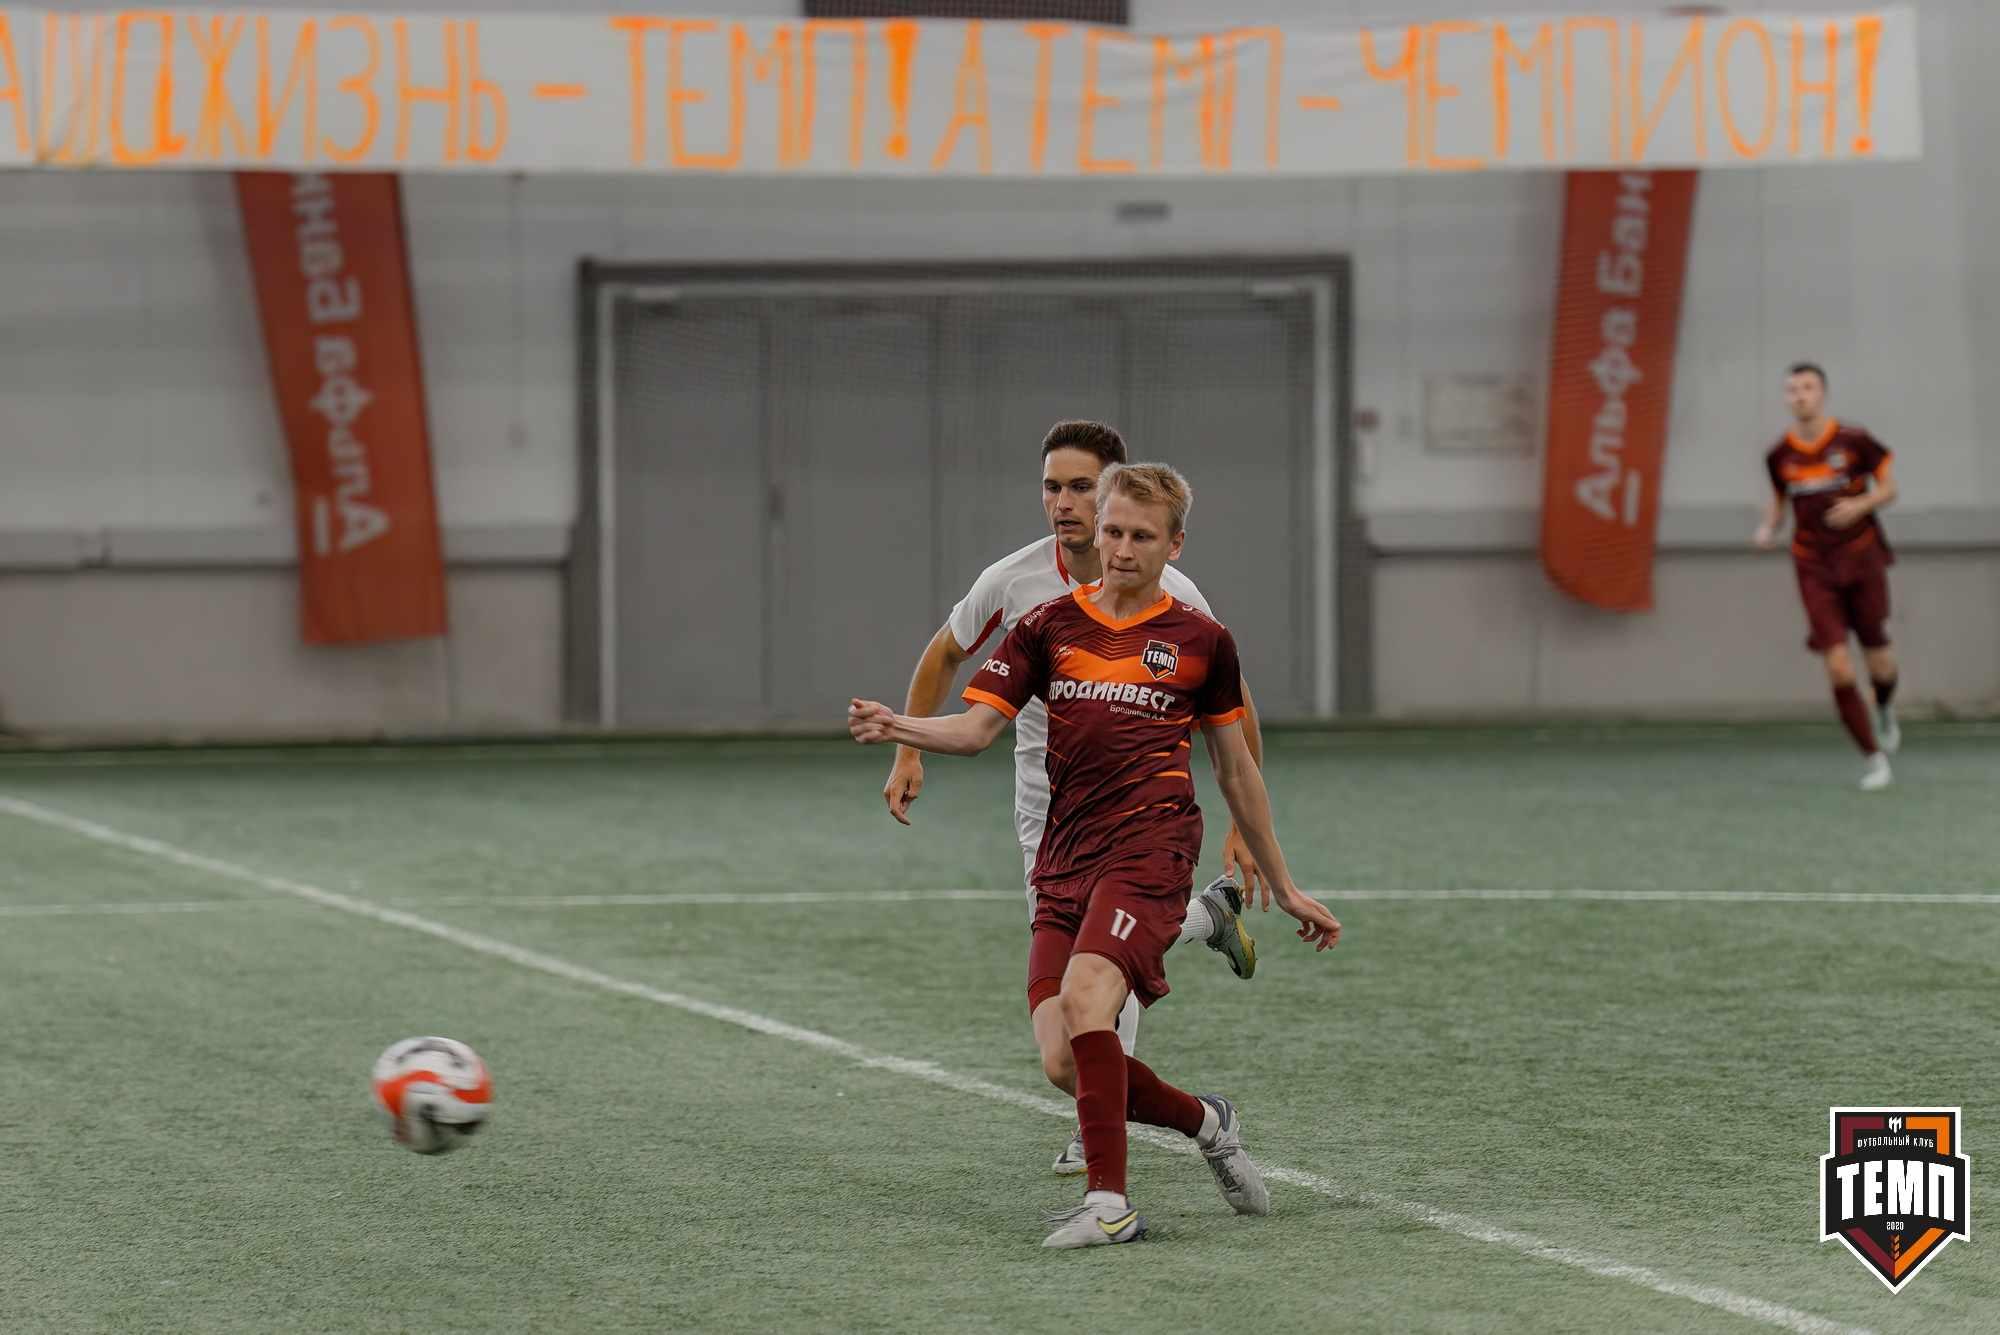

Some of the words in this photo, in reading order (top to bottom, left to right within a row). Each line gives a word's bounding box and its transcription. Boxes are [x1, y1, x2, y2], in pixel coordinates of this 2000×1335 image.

[1361, 16, 1883, 170] ЧЕМПИОН!
[1146, 650, 1175, 670] ТЕМП
[1110, 908, 1137, 941] 17
